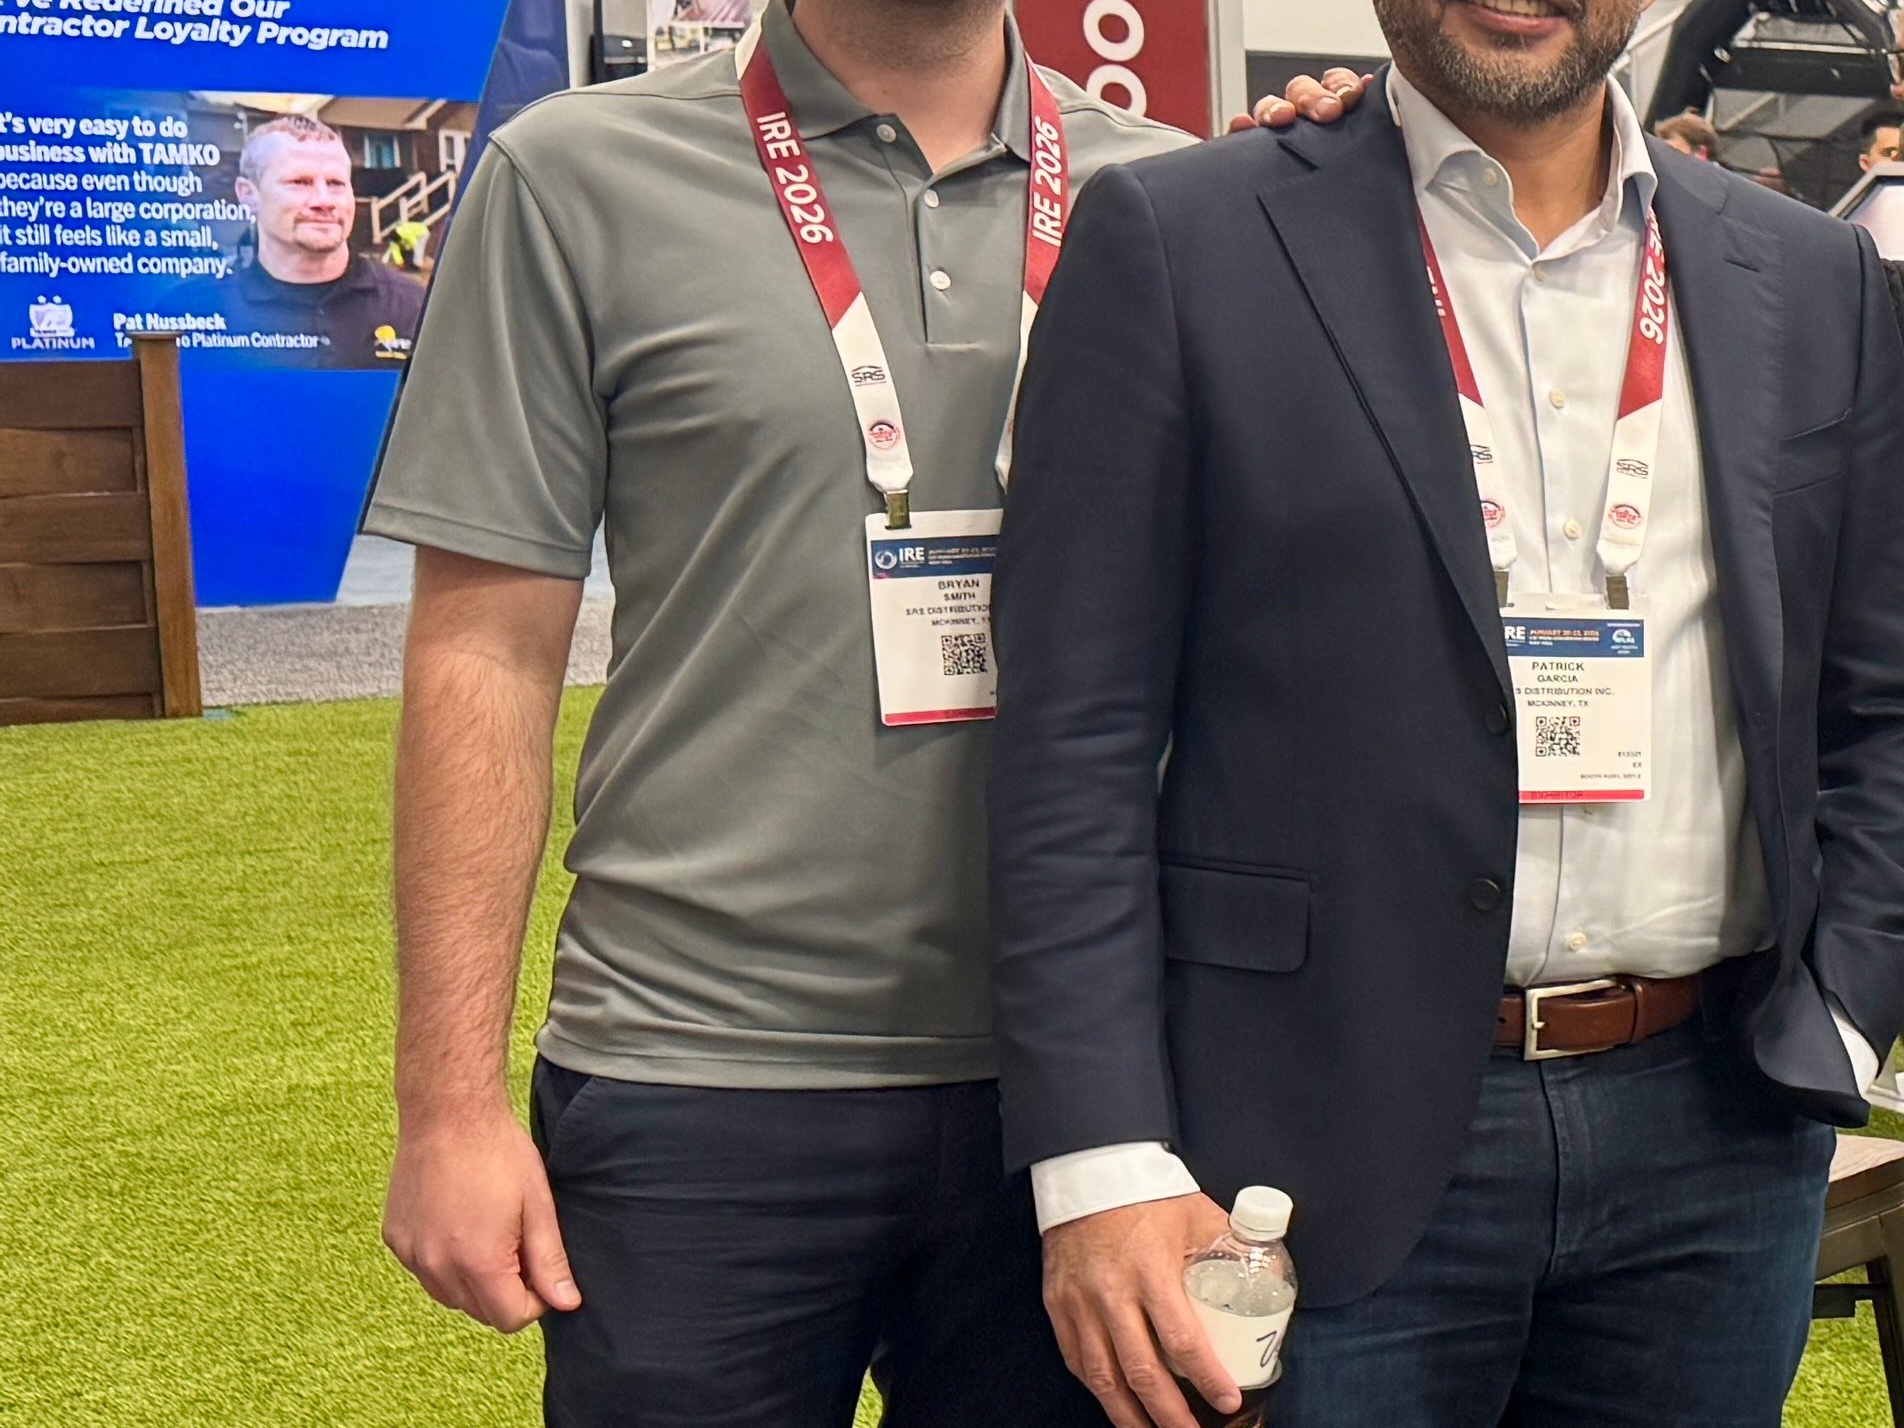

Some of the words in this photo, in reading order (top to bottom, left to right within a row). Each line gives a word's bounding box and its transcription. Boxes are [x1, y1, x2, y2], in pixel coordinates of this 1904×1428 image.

[135, 16, 251, 47] Loyalty
[257, 20, 389, 51] Program
[28, 116, 75, 139] very
[80, 119, 128, 140] easy
[132, 116, 156, 137] to
[160, 116, 188, 138] do
[88, 140, 136, 164] with
[139, 143, 220, 166] TAMKO
[1032, 114, 1061, 198] 2026
[82, 174, 130, 191] even
[132, 171, 202, 197] though
[756, 111, 797, 159] IRE
[778, 163, 833, 244] 2026
[70, 203, 82, 218] a
[86, 197, 135, 222] large
[139, 199, 256, 224] corporation,
[1031, 195, 1061, 247] IRE
[16, 225, 50, 245] still
[54, 224, 102, 246] feels
[106, 225, 140, 246] like
[145, 230, 157, 246] a
[161, 226, 218, 250] small,
[0, 251, 132, 278] family-owned
[137, 259, 233, 278] company.
[1639, 265, 1666, 344] 2026
[114, 313, 143, 330] Pat
[11, 337, 96, 349] PLATINUM
[193, 332, 249, 348] Platinum
[252, 333, 318, 348] Contractor
[852, 369, 886, 384] SRS
[899, 547, 925, 562] IRE
[938, 579, 980, 590] BRYAN
[943, 592, 976, 602] SMITH
[1532, 661, 1584, 672] PATRICK
[1537, 674, 1579, 683] GARCIA
[1525, 687, 1592, 696] DISTRIBUTION
